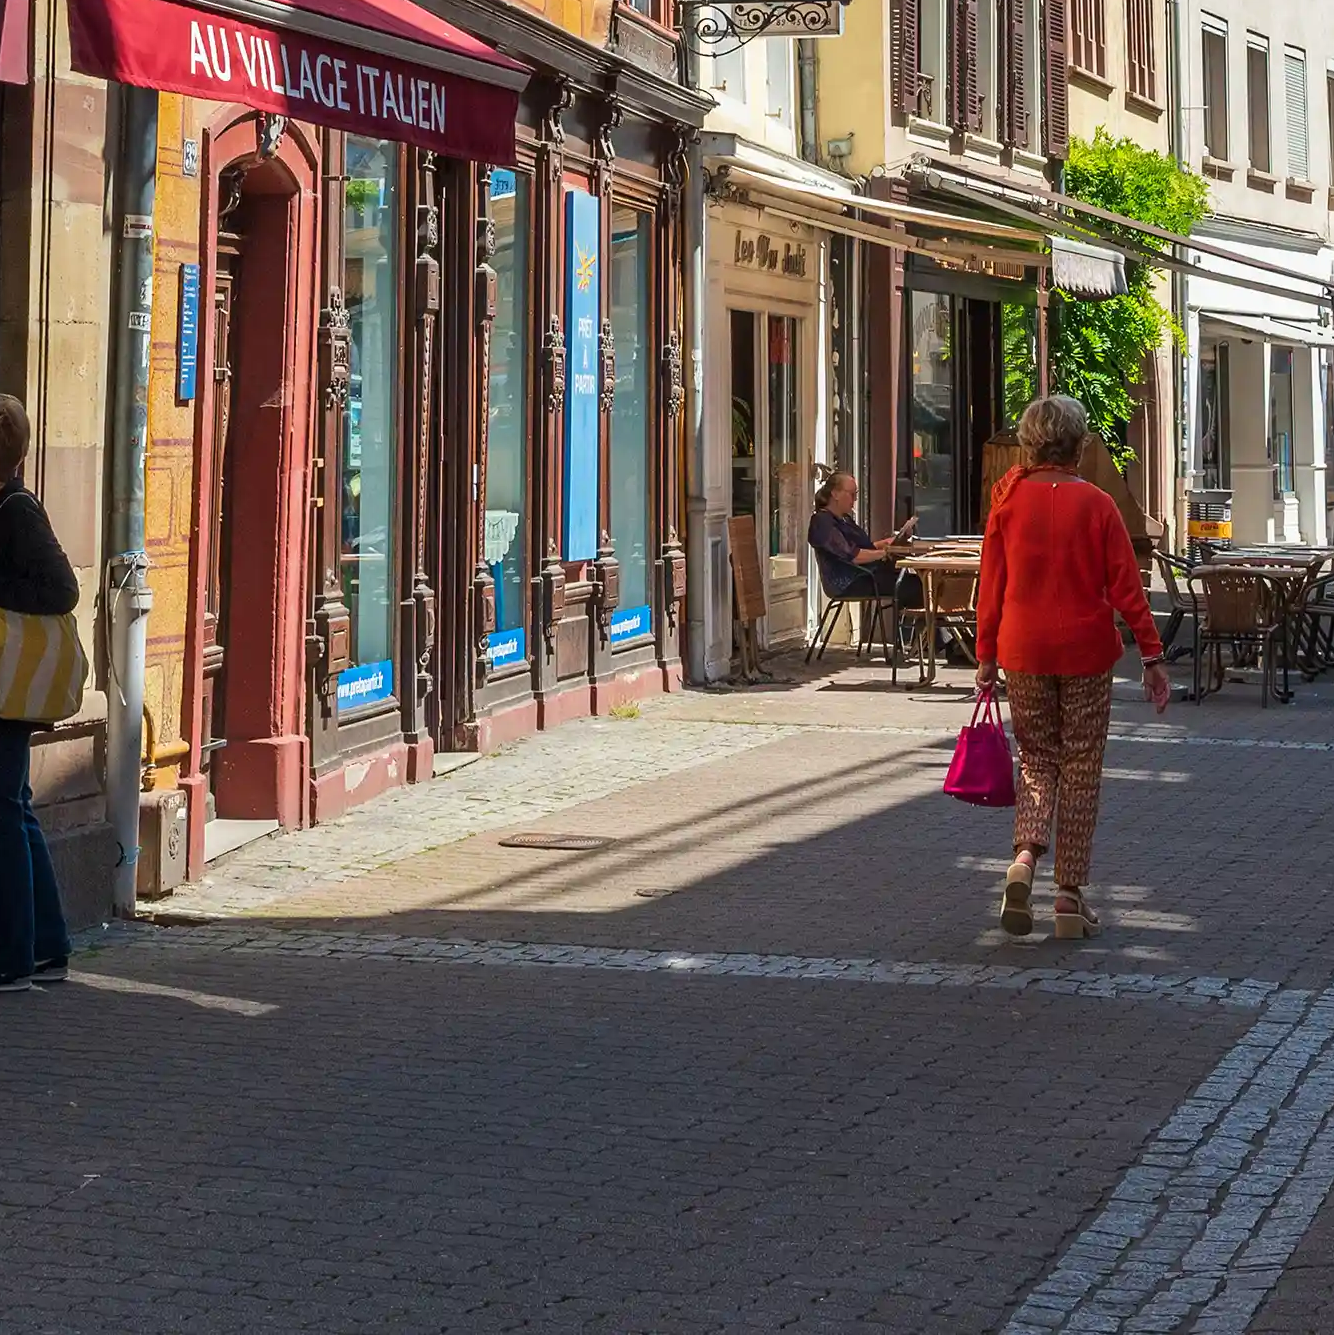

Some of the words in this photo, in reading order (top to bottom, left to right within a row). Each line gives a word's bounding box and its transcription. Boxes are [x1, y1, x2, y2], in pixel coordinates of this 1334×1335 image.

[190, 20, 232, 82] AU
[235, 30, 351, 112] VILLAGE
[356, 64, 447, 134] ITALIEN
[574, 374, 596, 395] PARTIR
